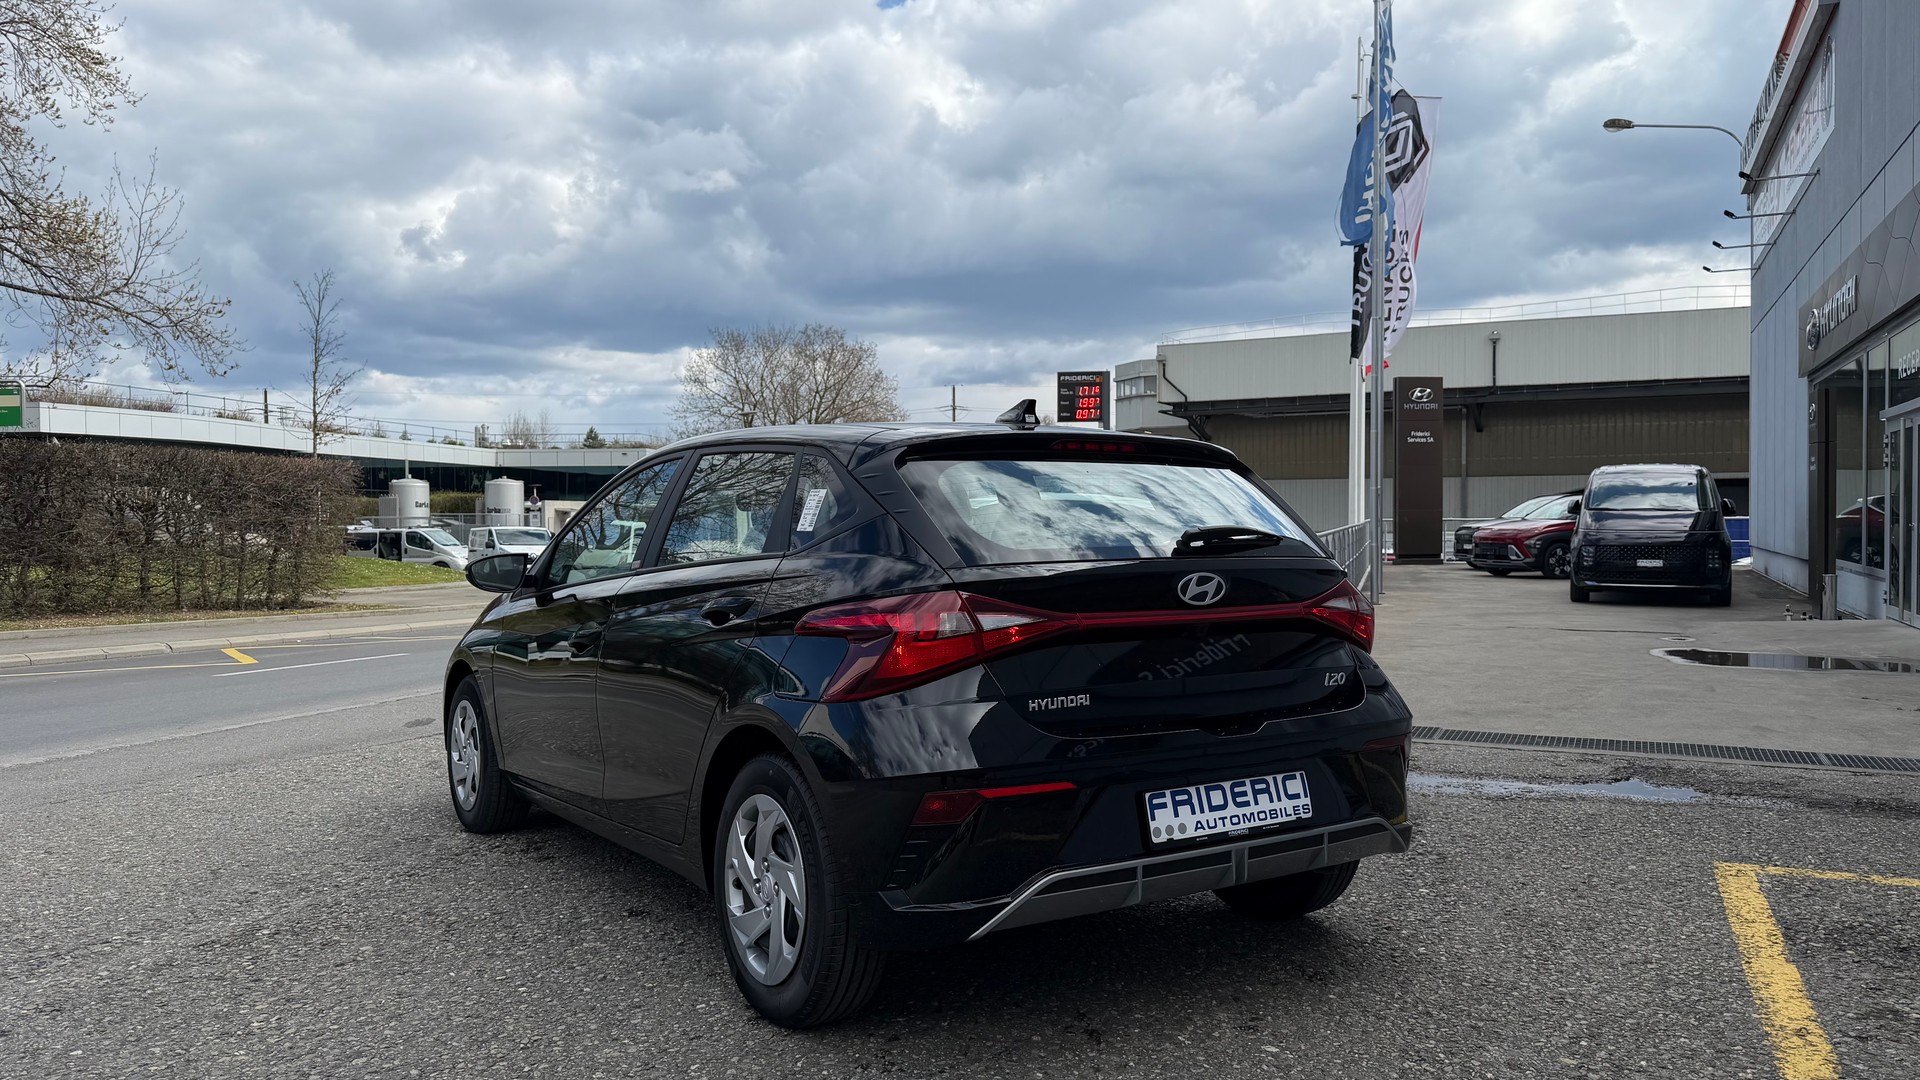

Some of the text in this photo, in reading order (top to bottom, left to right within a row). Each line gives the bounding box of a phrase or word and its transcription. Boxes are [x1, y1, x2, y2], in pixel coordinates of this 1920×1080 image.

[1820, 275, 1858, 338] HYUNDAI
[1898, 348, 1920, 380] RECEP
[1028, 693, 1091, 712] HYUNDAI
[1147, 772, 1309, 822] FRIDERICI
[1194, 803, 1312, 832] AUTOMOBILES
